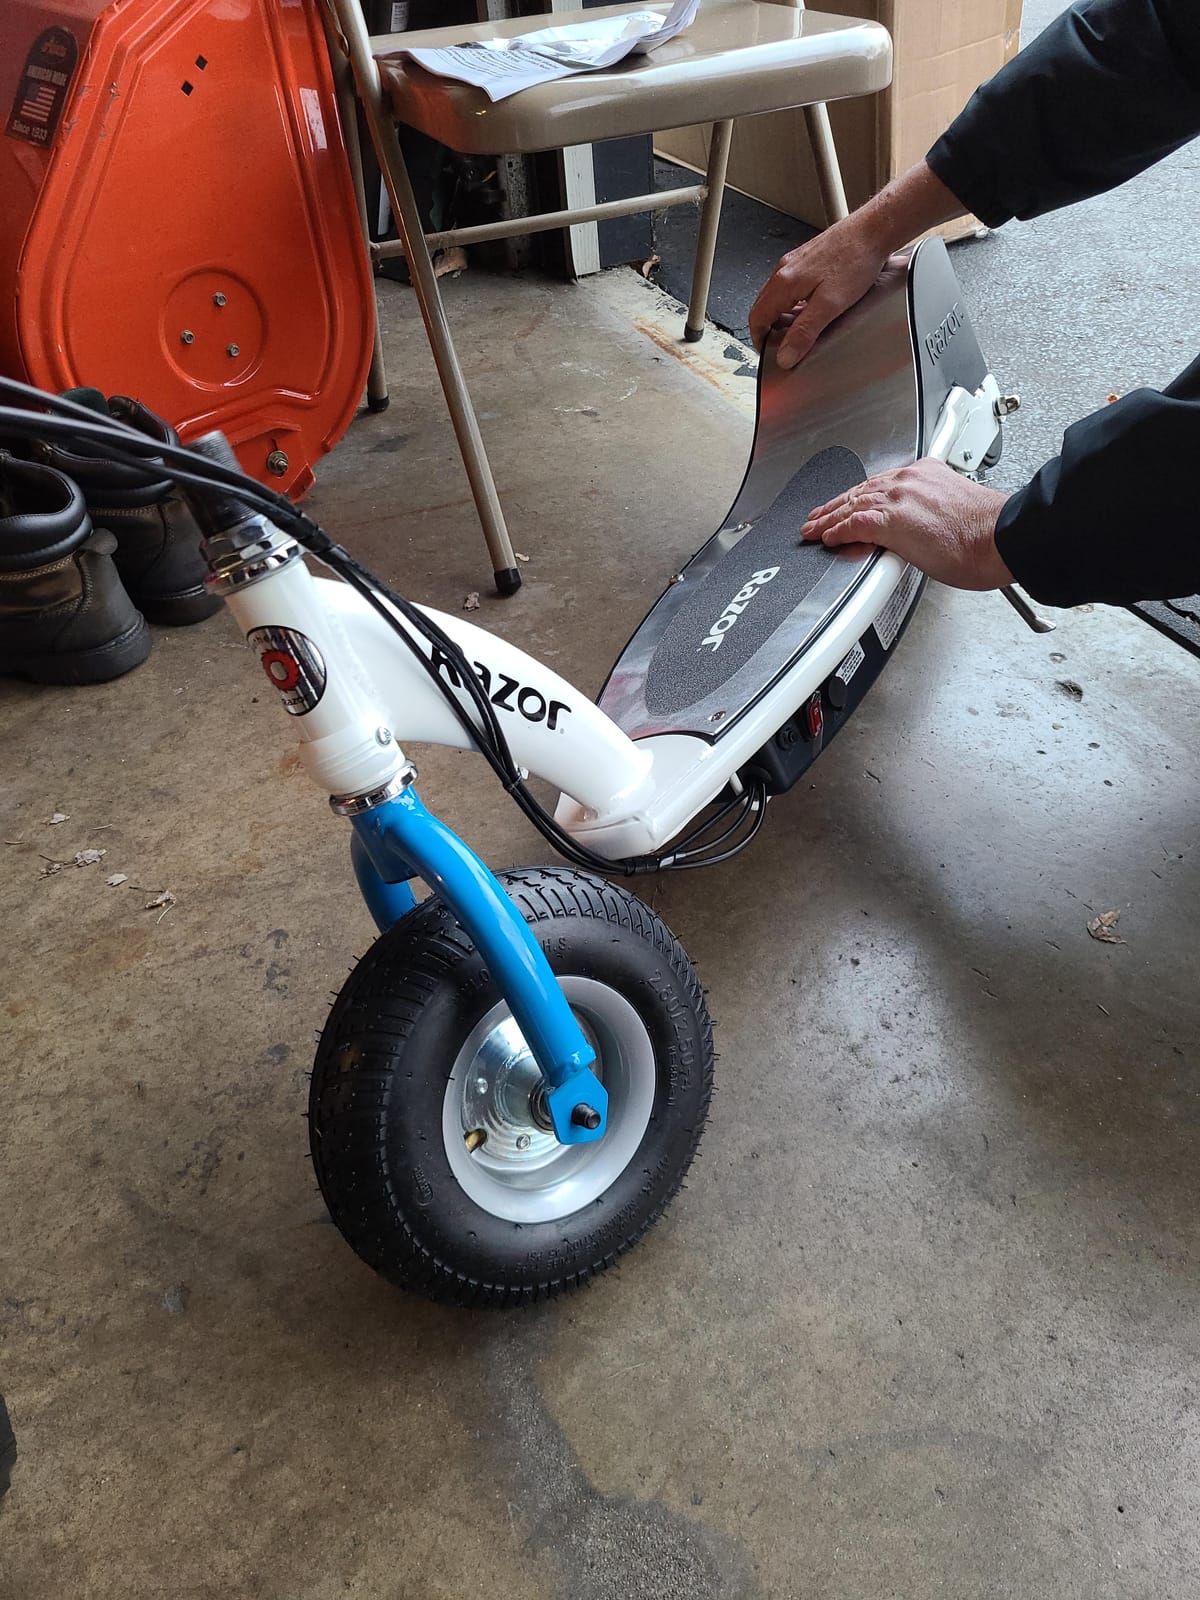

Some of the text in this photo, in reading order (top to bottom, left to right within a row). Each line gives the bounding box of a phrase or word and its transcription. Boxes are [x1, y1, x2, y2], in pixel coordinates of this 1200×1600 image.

[924, 302, 961, 366] Razor
[701, 566, 781, 652] Razor
[430, 645, 572, 731] Razor
